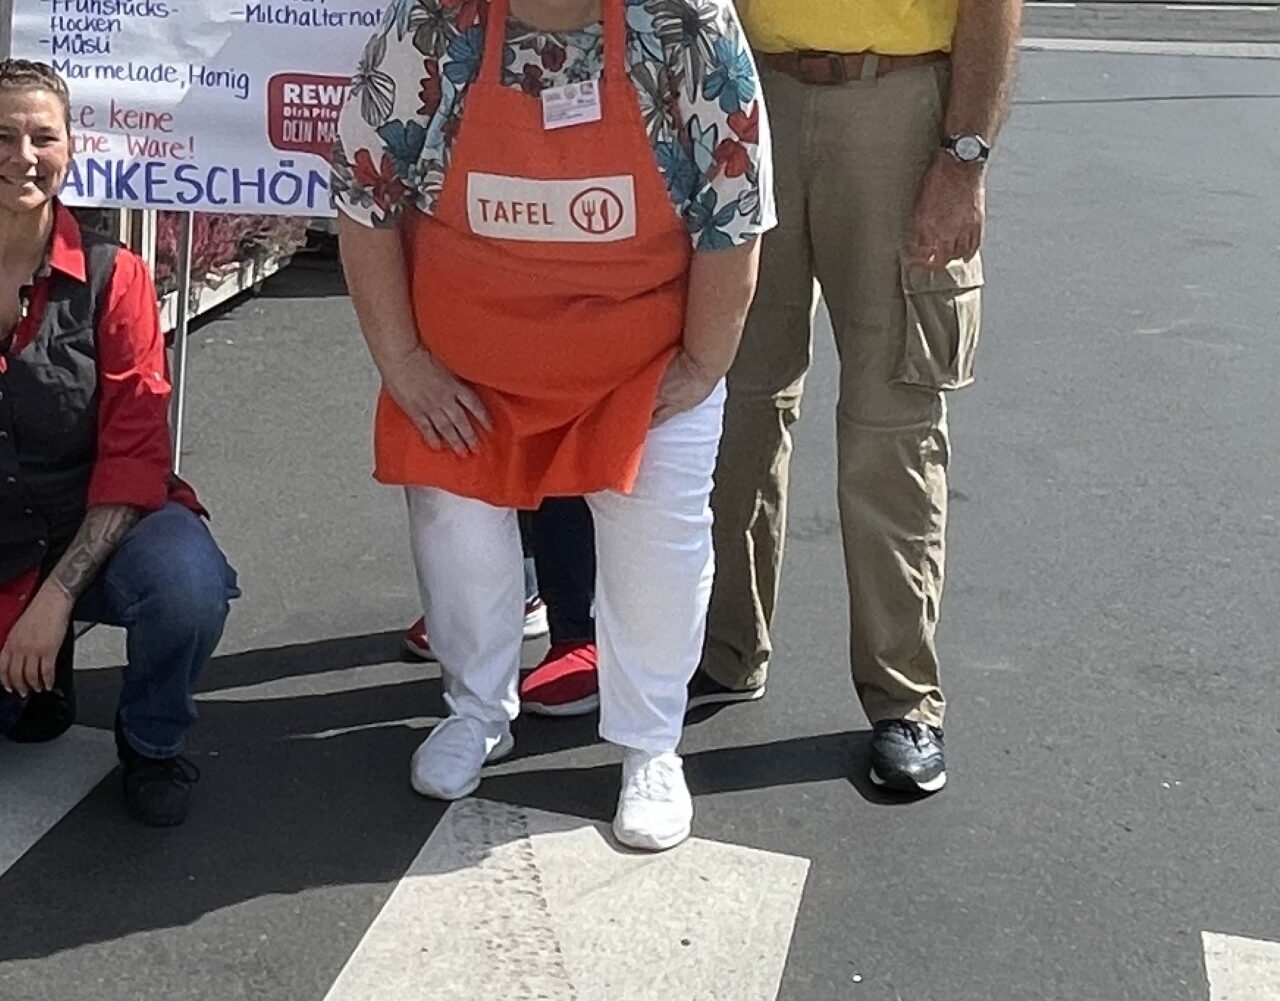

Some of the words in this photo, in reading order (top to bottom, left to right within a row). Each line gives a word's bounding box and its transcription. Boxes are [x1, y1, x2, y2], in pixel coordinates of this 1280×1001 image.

[50, 16, 122, 33] flocken
[189, 64, 250, 100] Honig
[109, 98, 174, 133] keine
[282, 119, 313, 142] DEIN
[127, 133, 195, 160] Ware!
[62, 156, 338, 209] ANKESCHÖN
[477, 198, 555, 226] TAFEL
